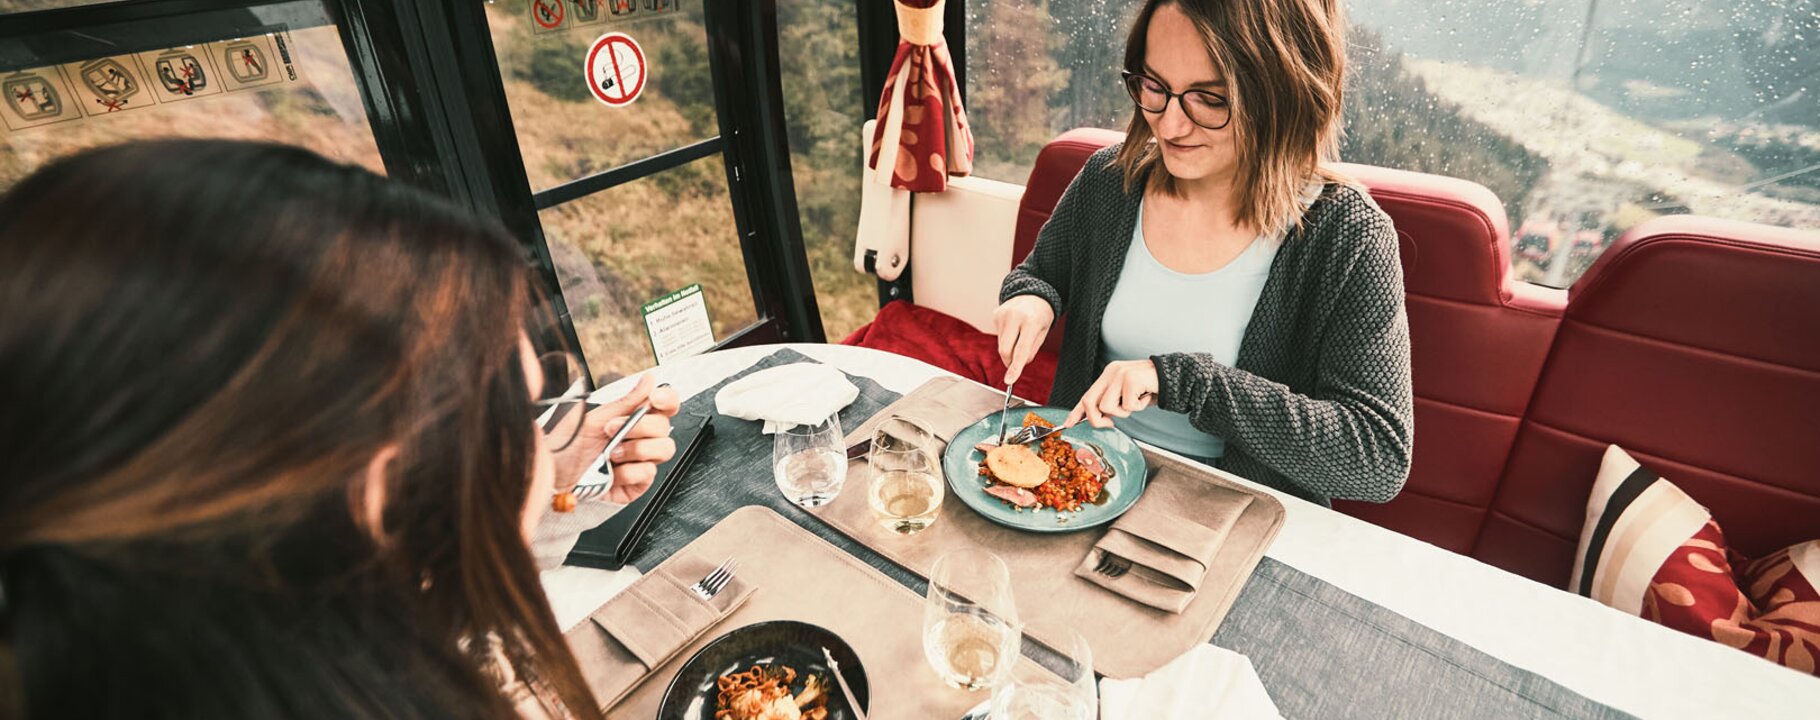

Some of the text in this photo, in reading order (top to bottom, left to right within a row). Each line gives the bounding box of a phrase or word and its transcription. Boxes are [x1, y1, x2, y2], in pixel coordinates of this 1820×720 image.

[645, 284, 699, 312] Verhalten im Notfall
